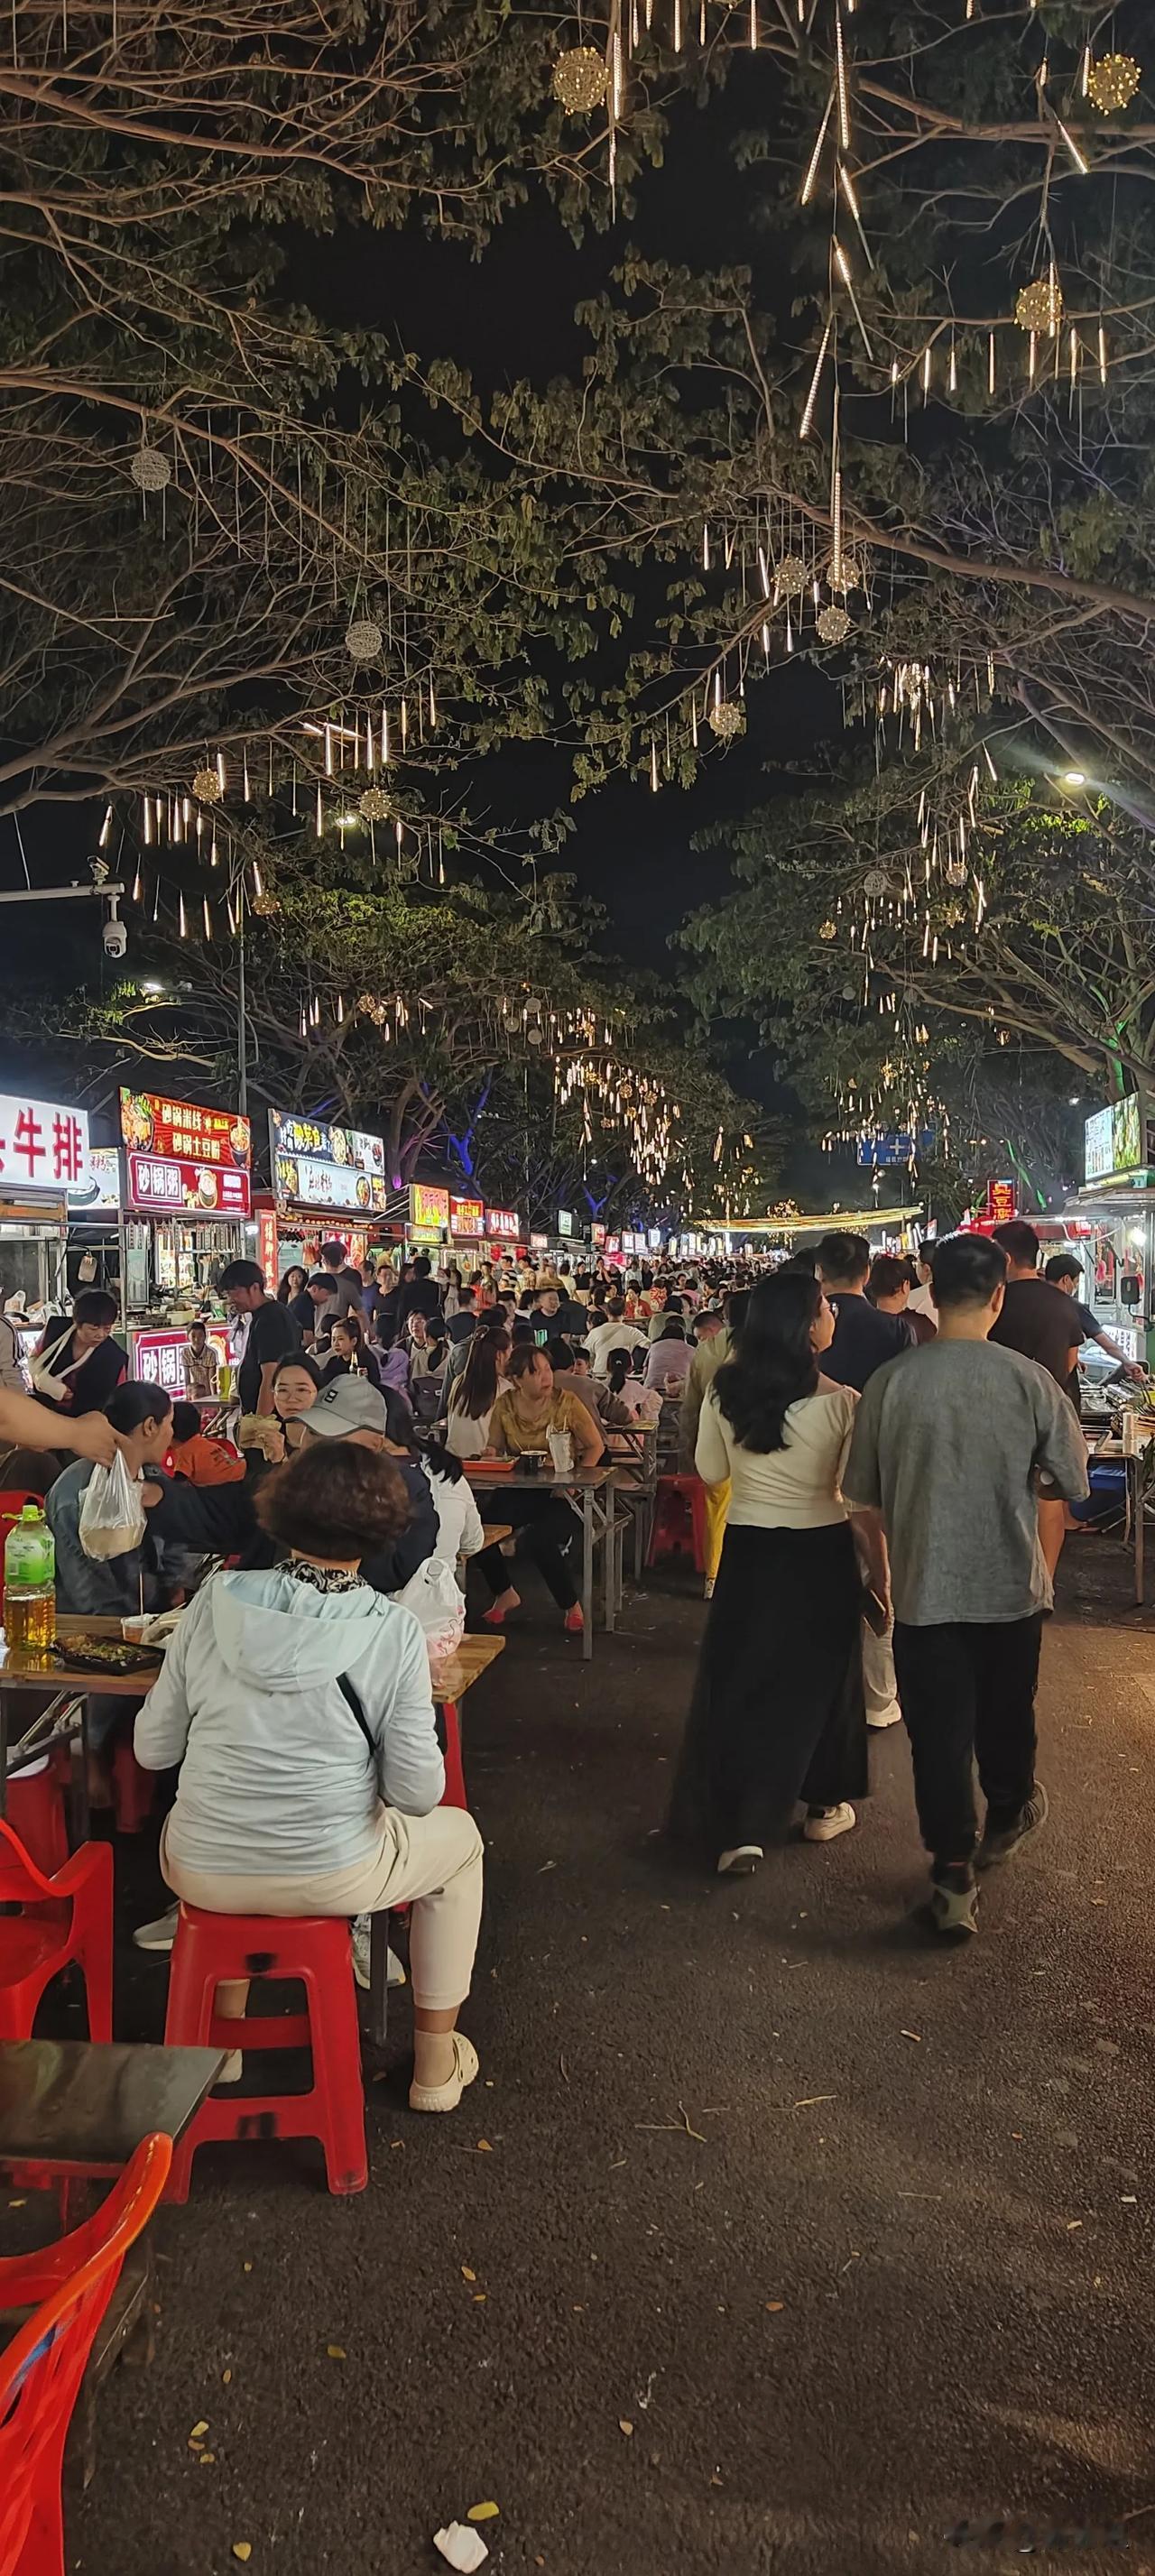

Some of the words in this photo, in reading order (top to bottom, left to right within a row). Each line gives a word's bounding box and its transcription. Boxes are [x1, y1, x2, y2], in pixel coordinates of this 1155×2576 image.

[162, 1103, 202, 1131] 砂锅米线
[0, 1107, 83, 1182] 牛排
[172, 1132, 221, 1160] 砂锅土豆粉
[137, 1164, 179, 1196] 砂锅粥
[992, 1183, 1012, 1220] 臭豆腐
